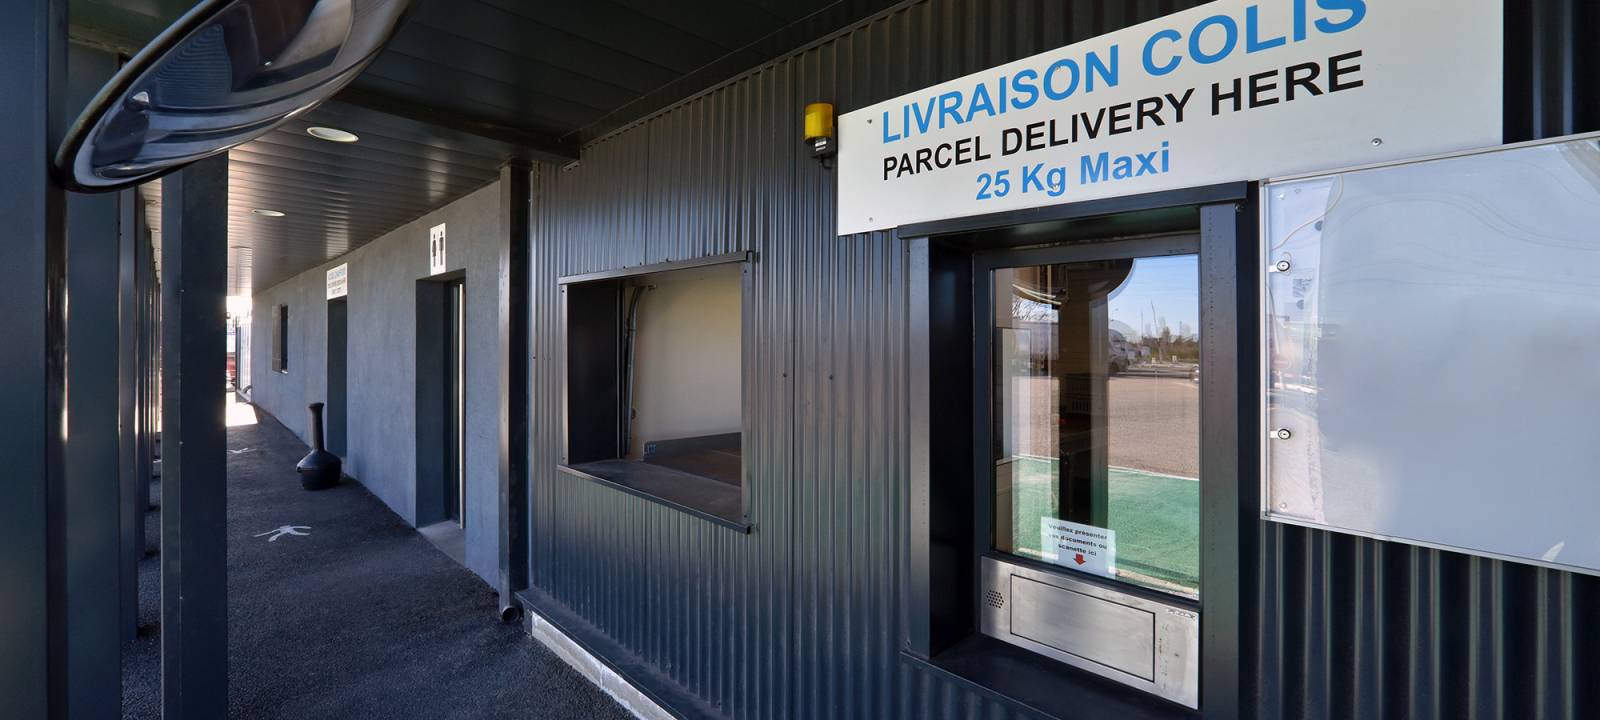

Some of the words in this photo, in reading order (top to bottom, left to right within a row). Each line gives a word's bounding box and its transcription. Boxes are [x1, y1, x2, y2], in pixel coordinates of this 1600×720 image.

[882, 44, 1119, 144] LIVRAISON
[1142, 0, 1367, 76] COLIS
[883, 136, 991, 180] PARCEL
[1002, 88, 1195, 156] DELIVERY
[1211, 50, 1363, 116] HERE
[976, 170, 1010, 200] 25
[1022, 163, 1067, 197] Kg
[1080, 141, 1169, 185] Maxi
[1060, 535, 1097, 547] documents
